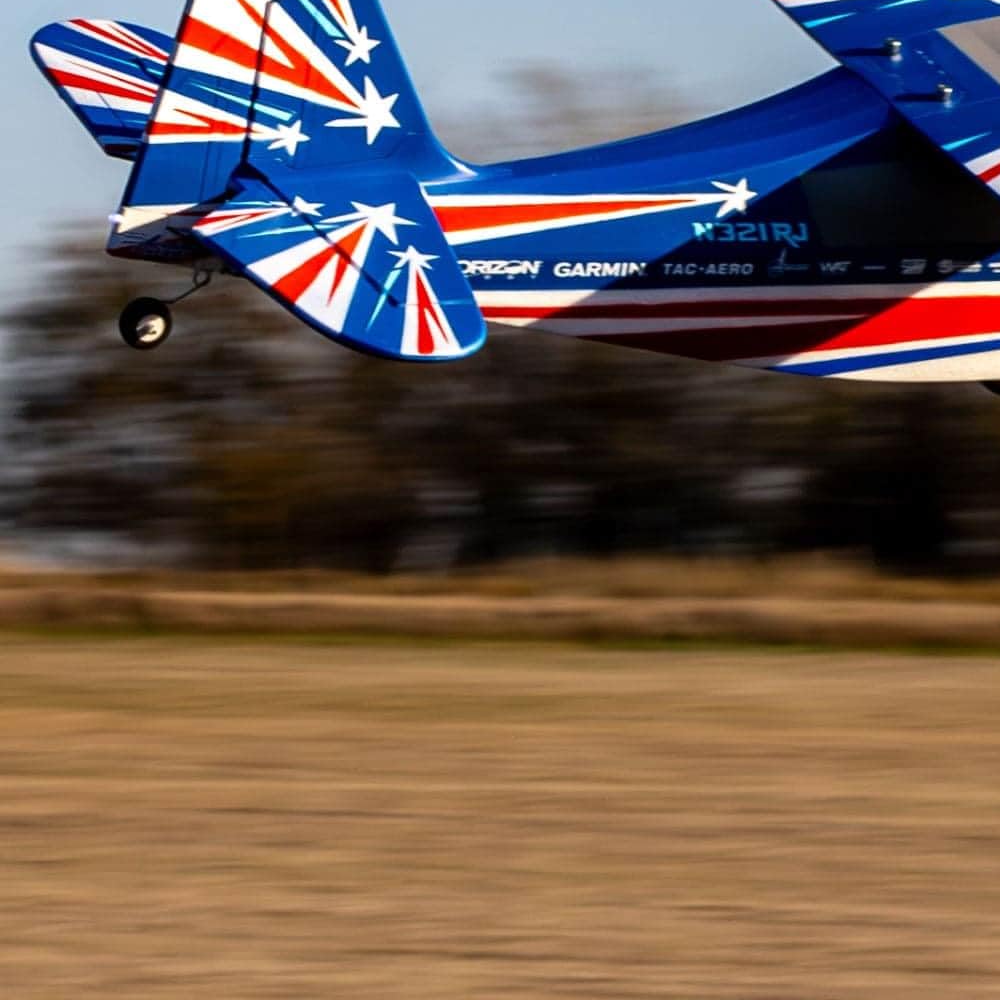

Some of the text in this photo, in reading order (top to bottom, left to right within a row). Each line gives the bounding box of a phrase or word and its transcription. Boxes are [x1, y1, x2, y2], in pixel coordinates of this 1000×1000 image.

[691, 221, 809, 248] N321RJ
[456, 259, 545, 275] ORIZON
[553, 261, 647, 278] GARMIN
